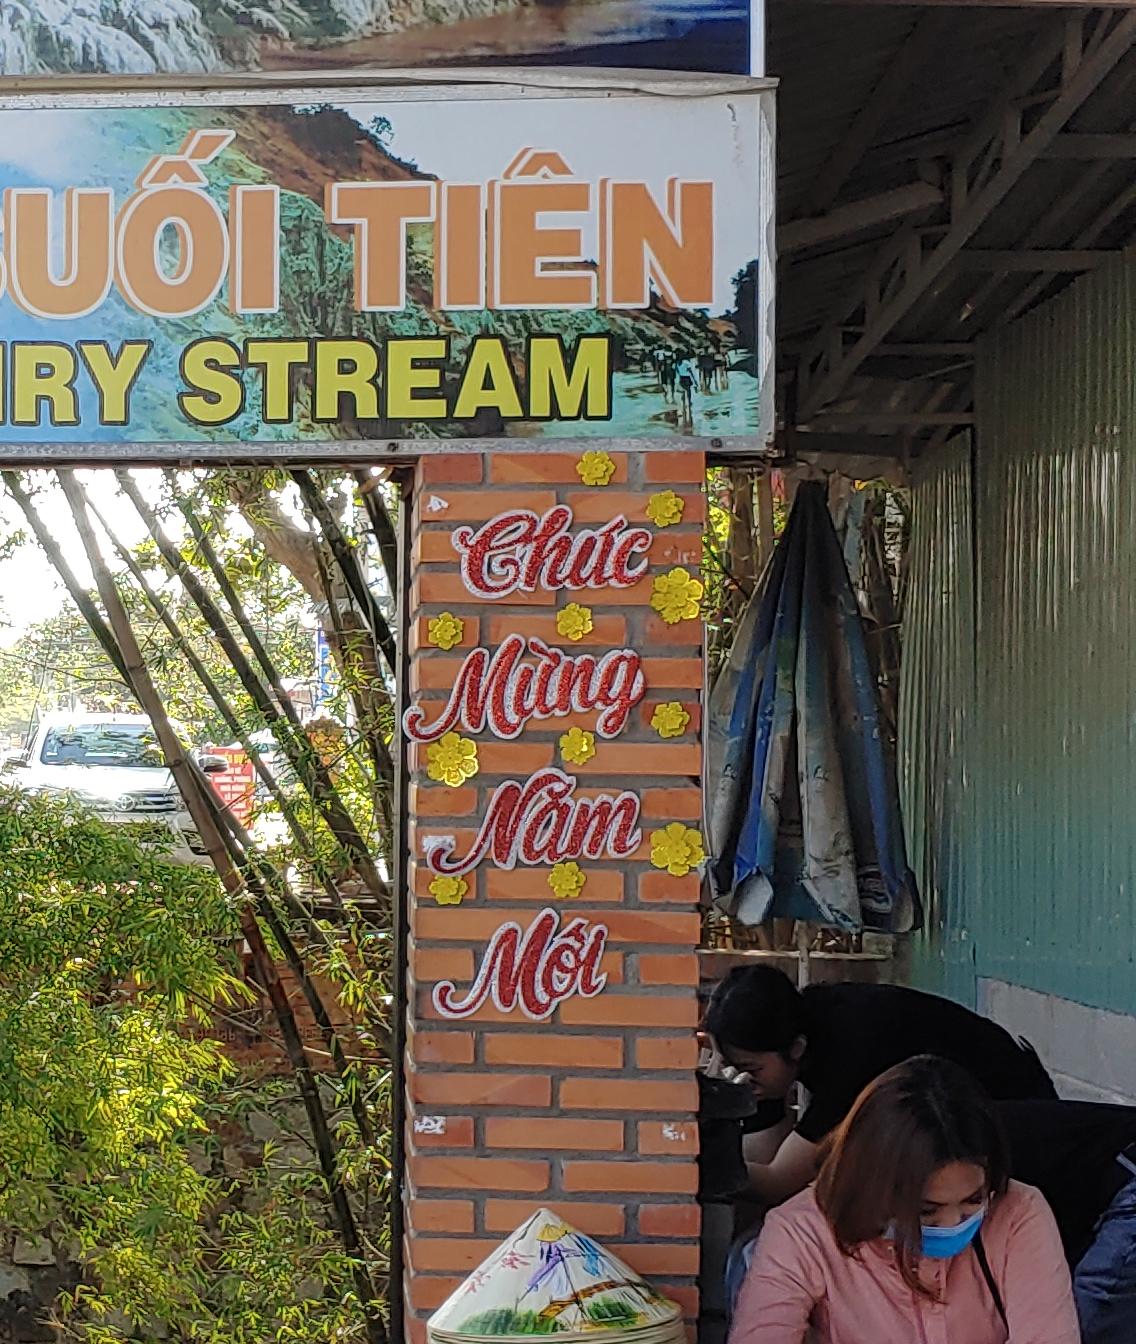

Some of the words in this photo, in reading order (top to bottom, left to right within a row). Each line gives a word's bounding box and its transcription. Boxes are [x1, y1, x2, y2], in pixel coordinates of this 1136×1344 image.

[325, 147, 715, 313] TIÊN
[178, 333, 613, 425] STREAM
[452, 504, 653, 599] Chúc
